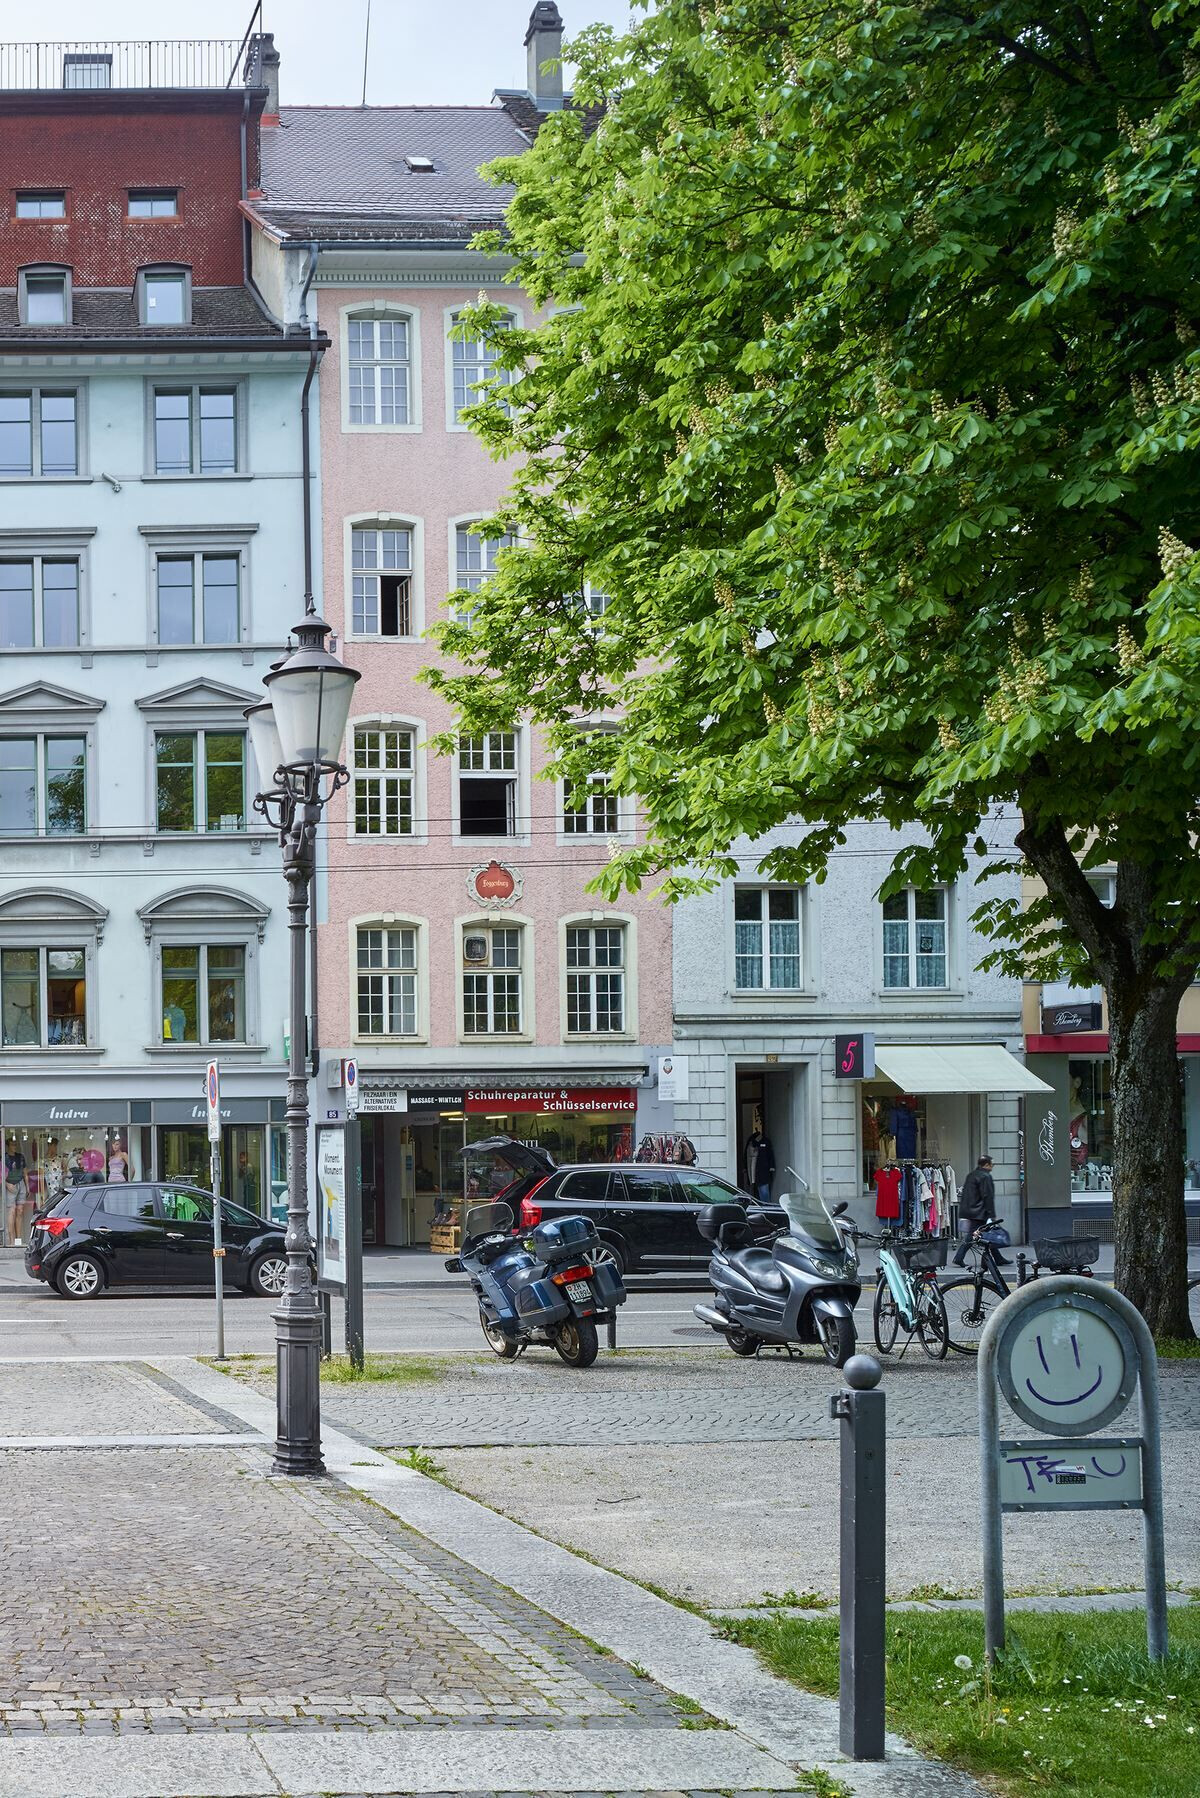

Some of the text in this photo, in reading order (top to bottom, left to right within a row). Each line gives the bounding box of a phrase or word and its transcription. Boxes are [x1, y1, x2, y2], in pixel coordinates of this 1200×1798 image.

[1052, 1011, 1082, 1027] Rhomberg
[841, 1040, 858, 1073] 5
[467, 1090, 568, 1101] Schuhreparatur &
[47, 1105, 91, 1119] Indra
[543, 1100, 635, 1110] Schlüsselservice
[1039, 1110, 1058, 1166] Rhomberg
